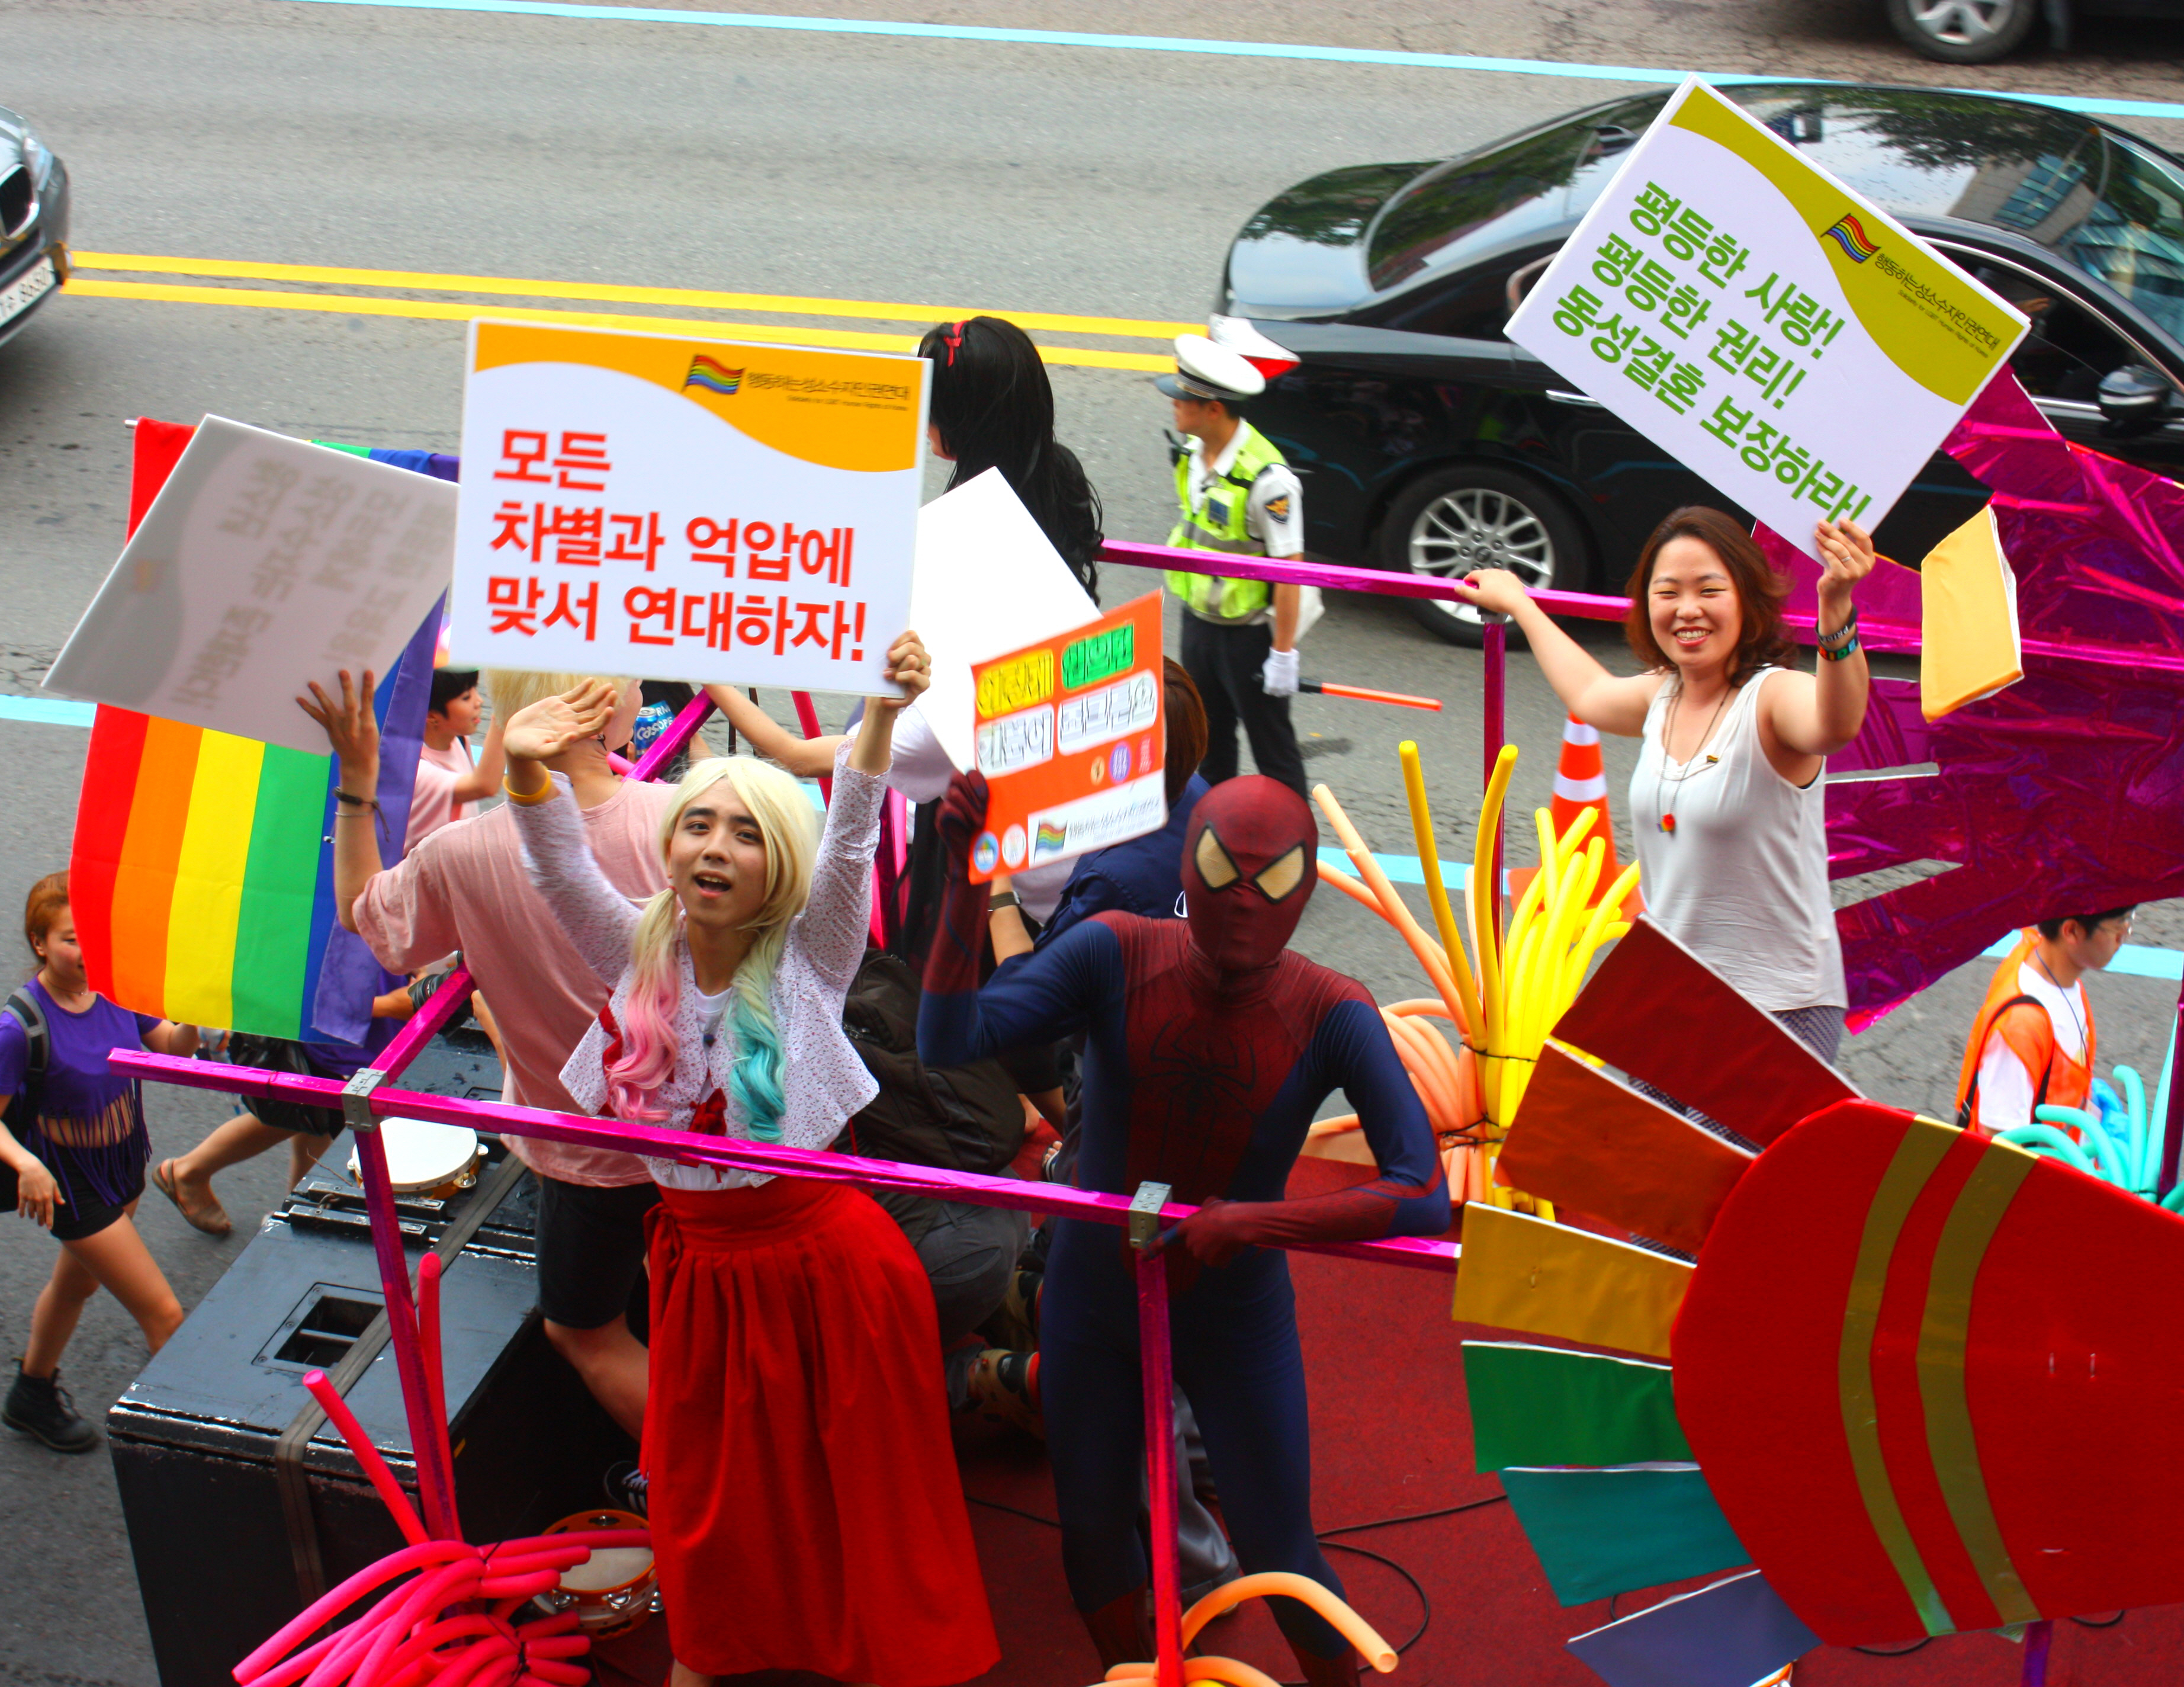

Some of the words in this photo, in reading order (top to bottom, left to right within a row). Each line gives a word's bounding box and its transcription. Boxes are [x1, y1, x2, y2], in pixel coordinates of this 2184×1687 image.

[1592, 232, 1712, 339] 평등한
[1707, 319, 1807, 410] 권리!
[1630, 181, 1750, 289] 평등한
[1745, 272, 1846, 360] 사랑!
[1553, 284, 1707, 415] 동성결혼
[494, 429, 611, 492] 모든
[490, 501, 665, 572] 차별과
[686, 517, 854, 588] 억압에
[487, 576, 599, 642] 맞서
[624, 586, 866, 662] 연대하자!
